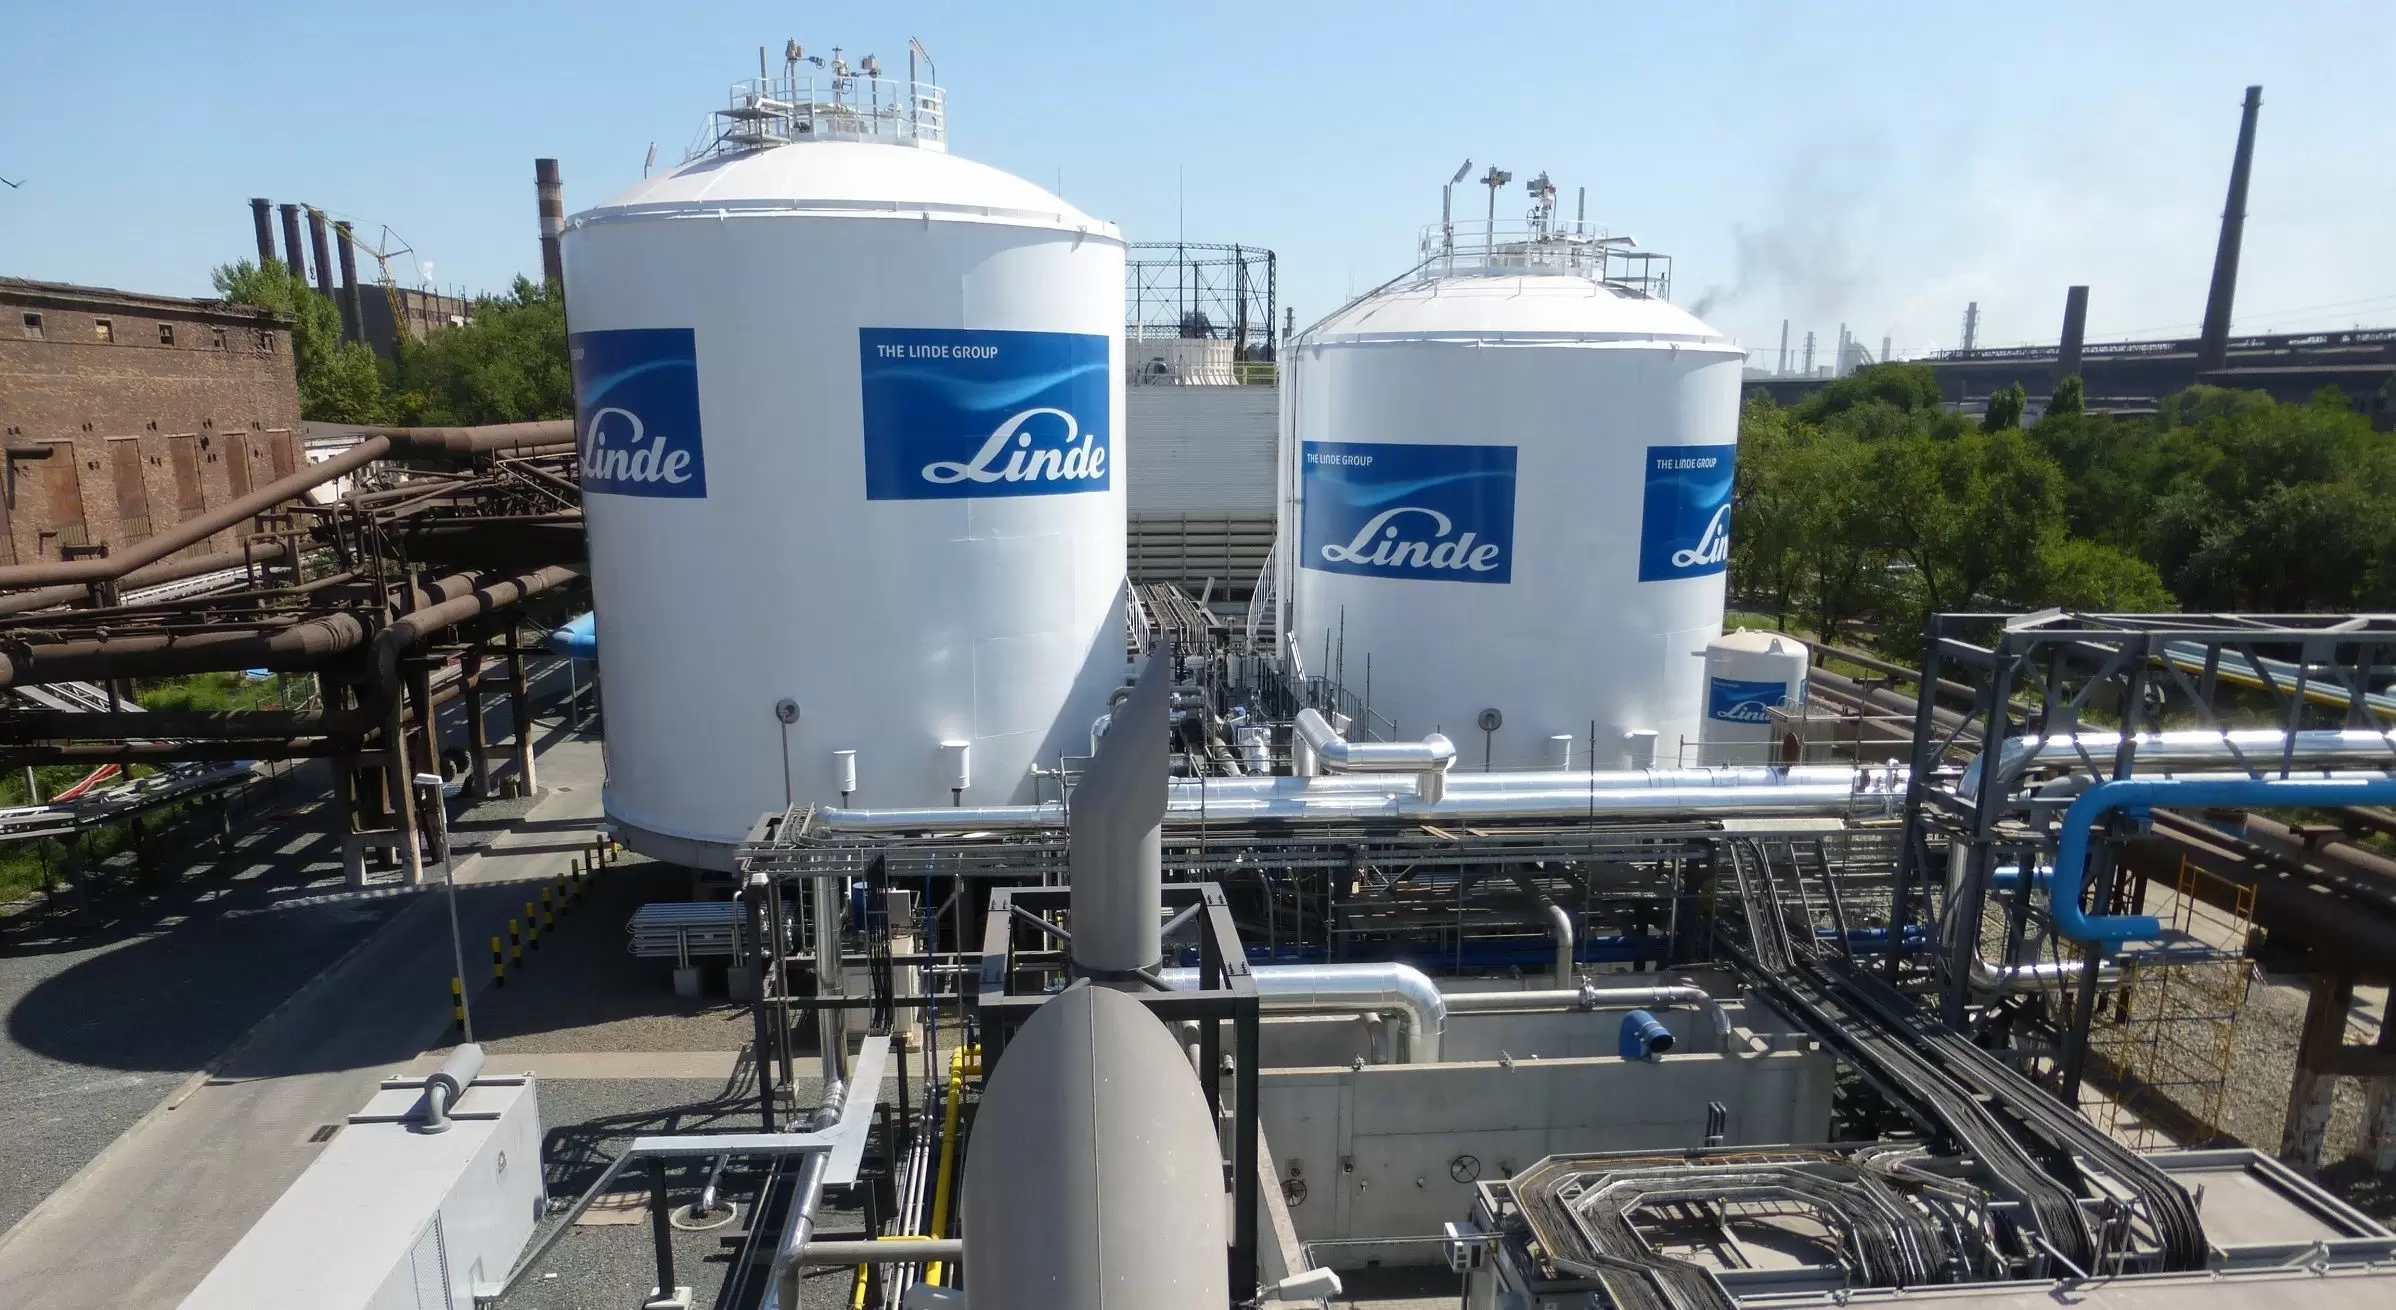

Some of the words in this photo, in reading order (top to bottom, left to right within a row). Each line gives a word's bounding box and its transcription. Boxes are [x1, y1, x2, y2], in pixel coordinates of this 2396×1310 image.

[877, 345, 905, 358] THE
[909, 345, 949, 358] LINDE
[952, 346, 998, 358] GROUP
[921, 407, 1105, 484] Linde
[1307, 453, 1319, 464] THE
[1320, 454, 1341, 465] LINDE
[1342, 455, 1373, 466] GROUP
[1656, 459, 1673, 469] THE
[1674, 459, 1696, 469] LINDE
[1696, 457, 1717, 469] GROUP
[1321, 507, 1499, 572] Linde
